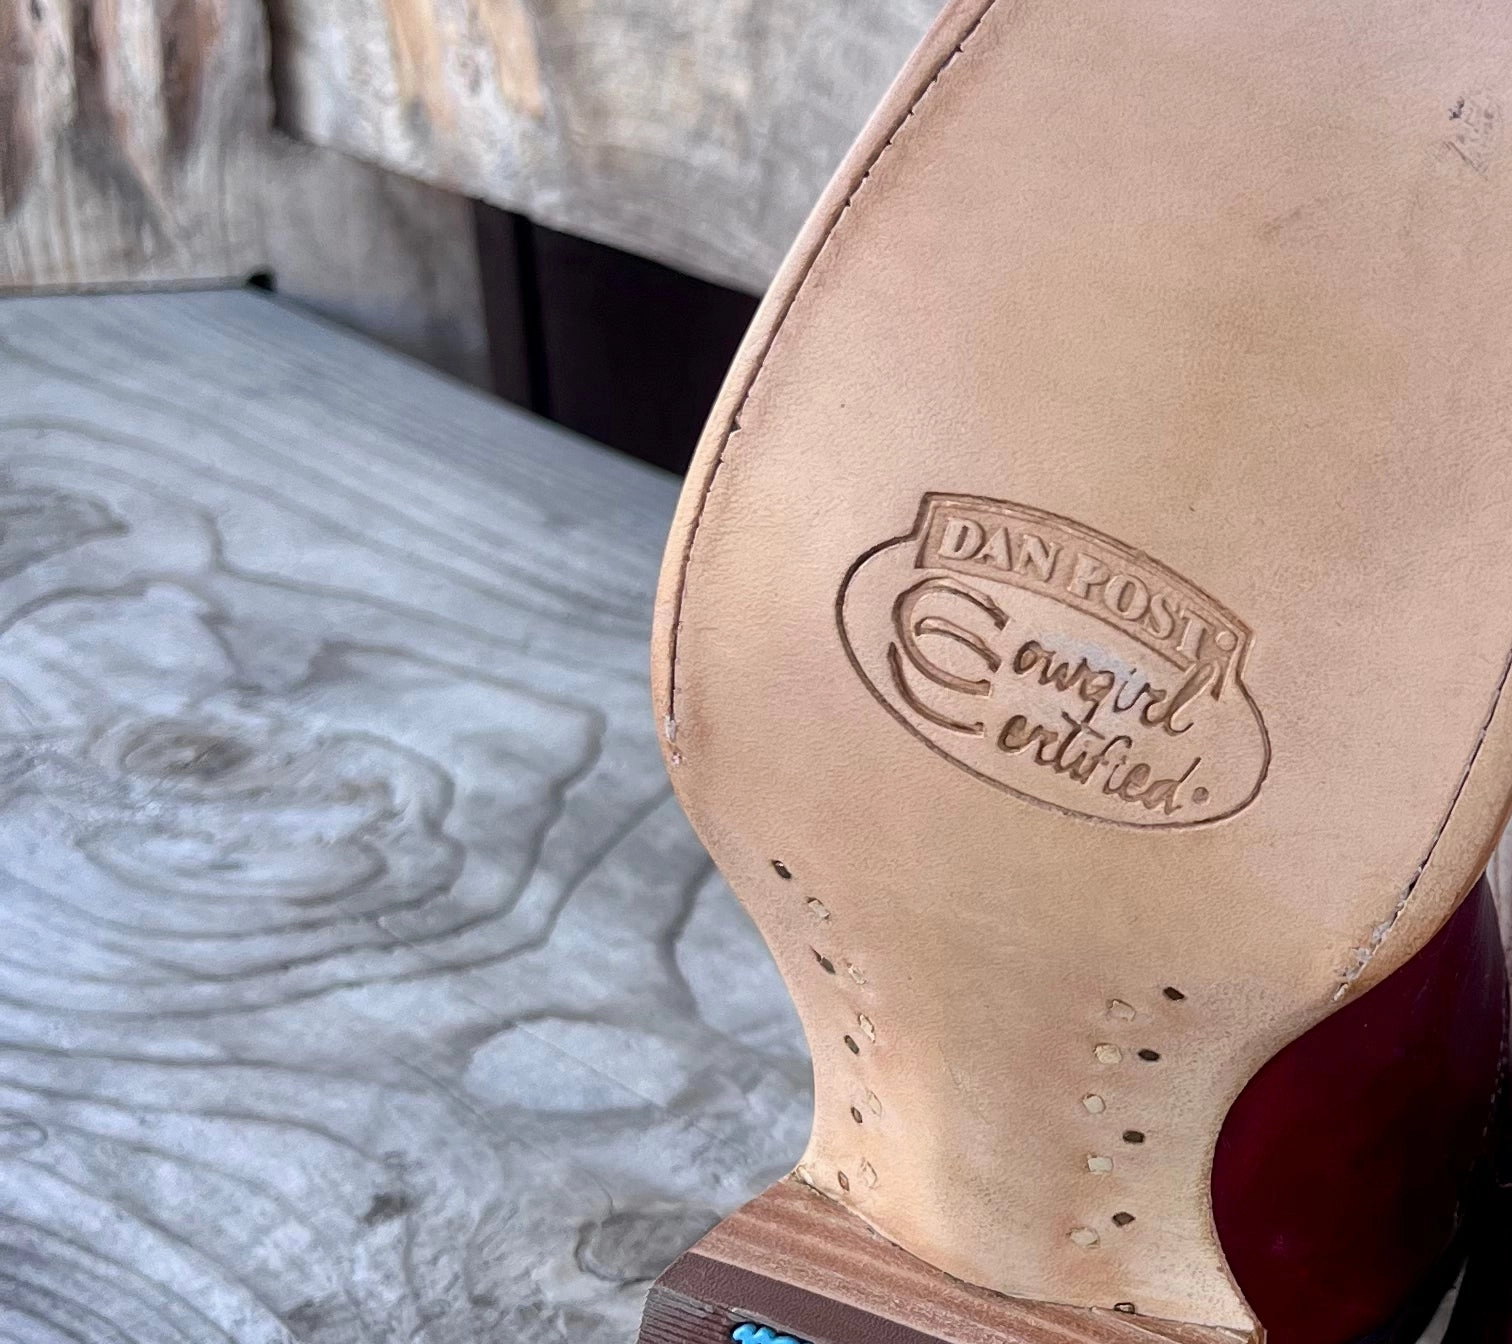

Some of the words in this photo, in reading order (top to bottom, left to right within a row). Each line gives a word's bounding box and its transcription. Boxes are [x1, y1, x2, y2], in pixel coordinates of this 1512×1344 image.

[893, 576, 1222, 737] Cowgirl
[937, 516, 1061, 582] DAN
[1066, 553, 1207, 653] POST
